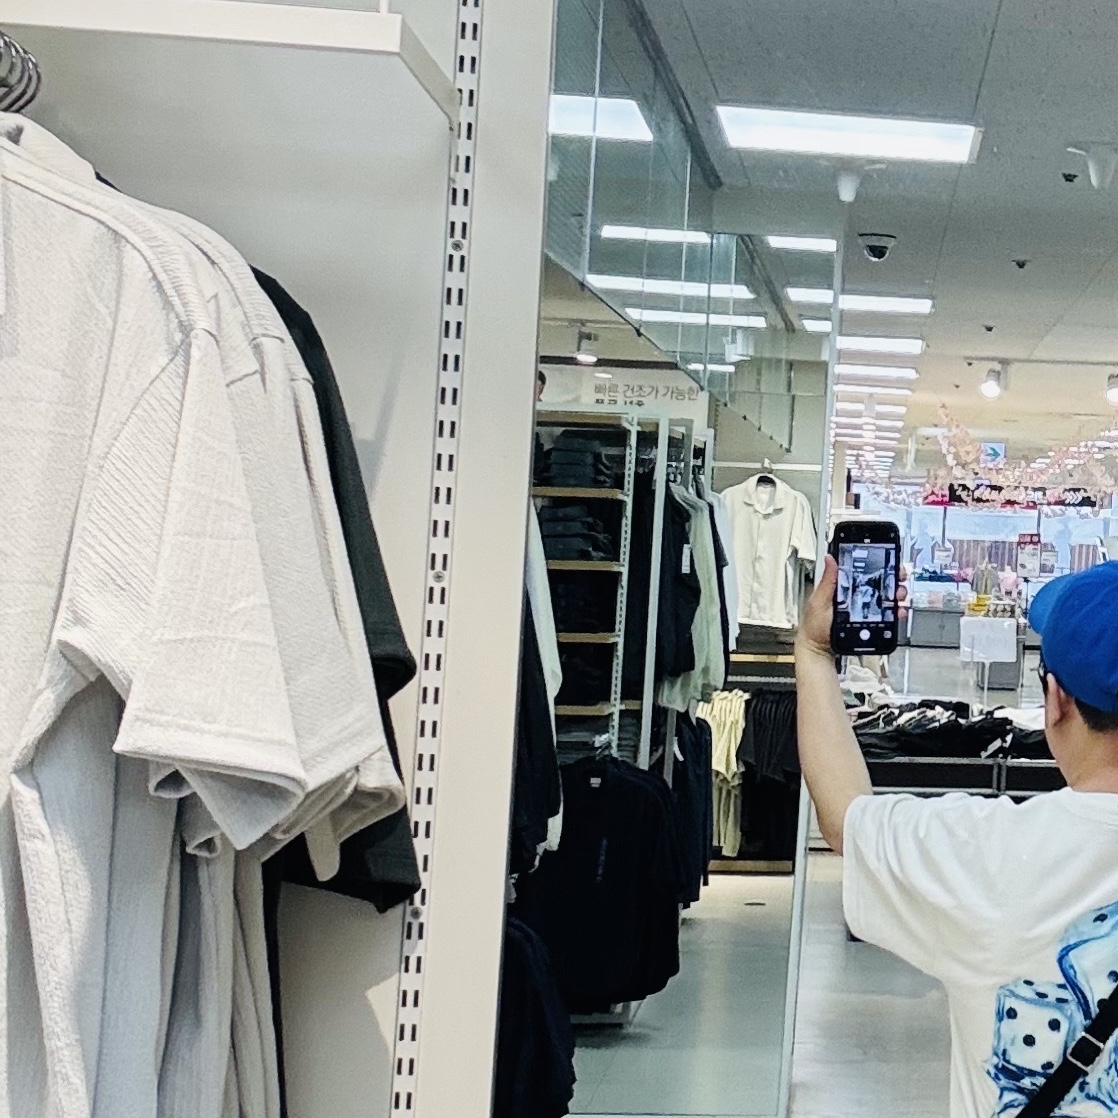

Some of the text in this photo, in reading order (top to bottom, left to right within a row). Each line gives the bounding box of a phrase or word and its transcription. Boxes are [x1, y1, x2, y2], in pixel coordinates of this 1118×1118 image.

[594, 383, 699, 401] 빠른 건조가 가능한
